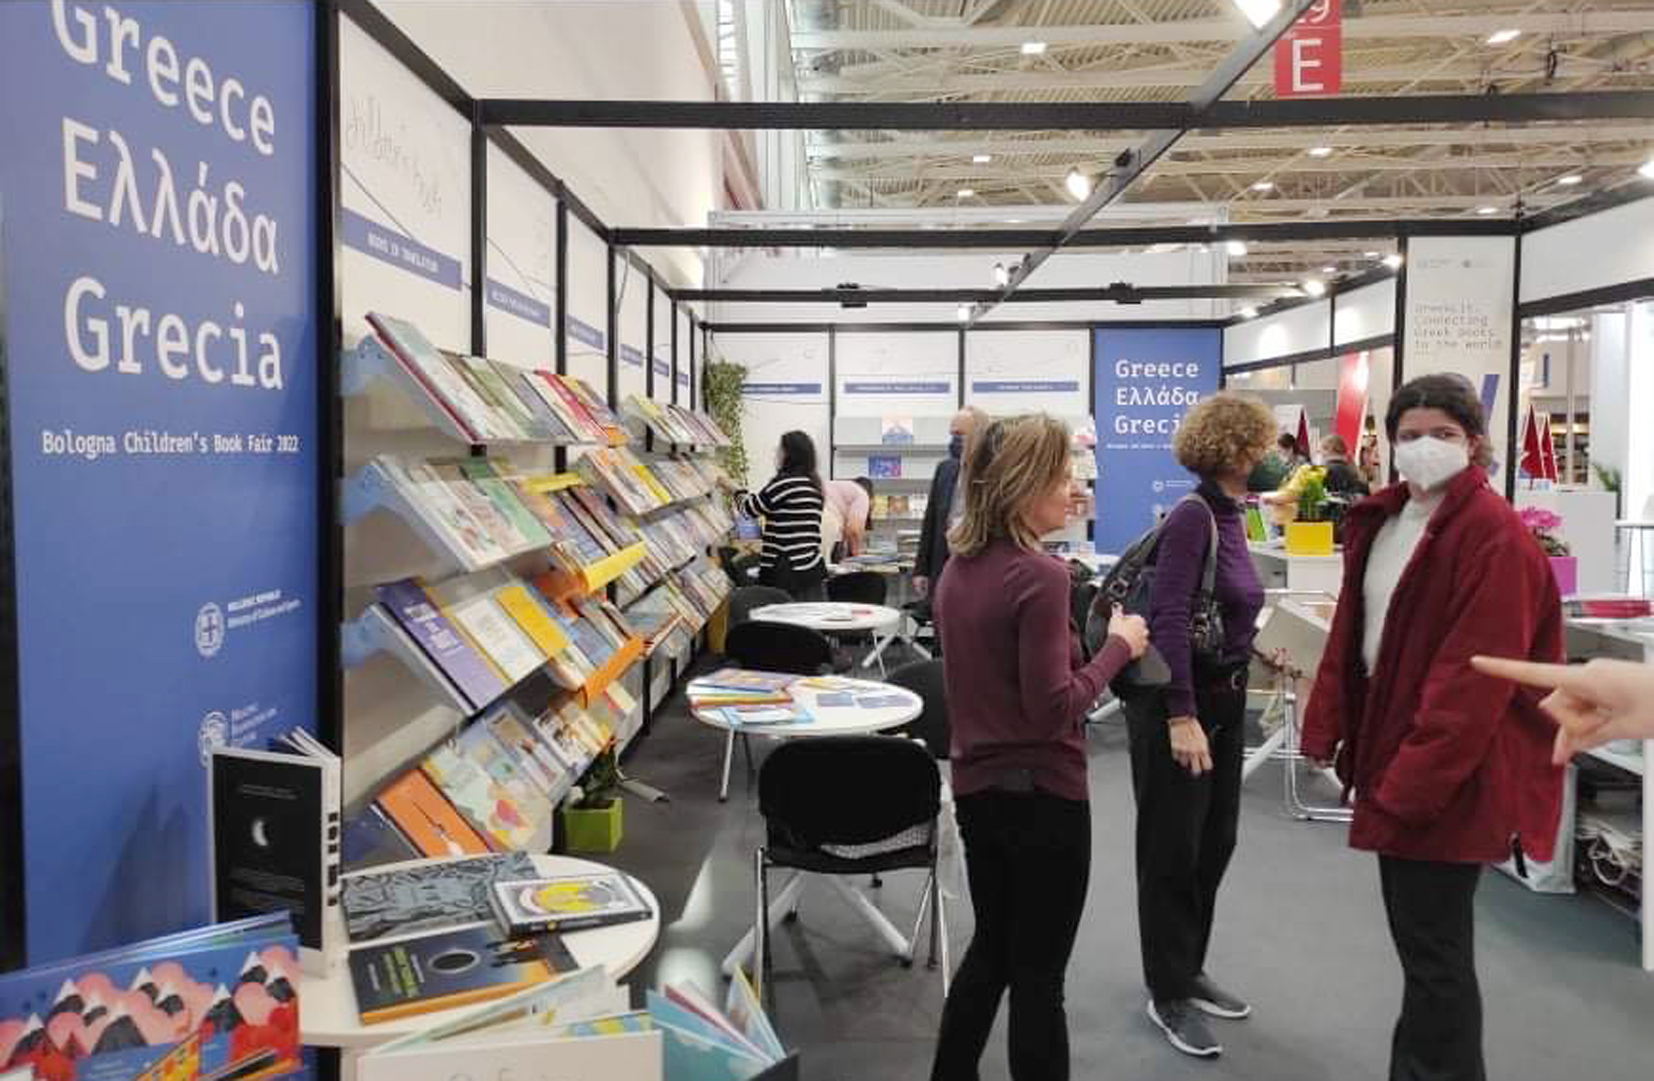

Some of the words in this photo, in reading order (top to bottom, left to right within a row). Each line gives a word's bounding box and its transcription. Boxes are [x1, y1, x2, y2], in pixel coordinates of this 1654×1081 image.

[51, 0, 274, 155] Greece
[1292, 38, 1324, 92] E
[62, 116, 279, 274] Ελλάδα
[64, 275, 283, 390] Grecia
[1115, 359, 1200, 378] Greece
[1116, 384, 1200, 406] Ελλάδα
[1114, 412, 1181, 434] Greci
[42, 430, 116, 459] Bologna
[124, 430, 208, 454] Children's
[213, 434, 243, 453] Book
[248, 434, 273, 452] Fair
[277, 434, 300, 453] 2022
